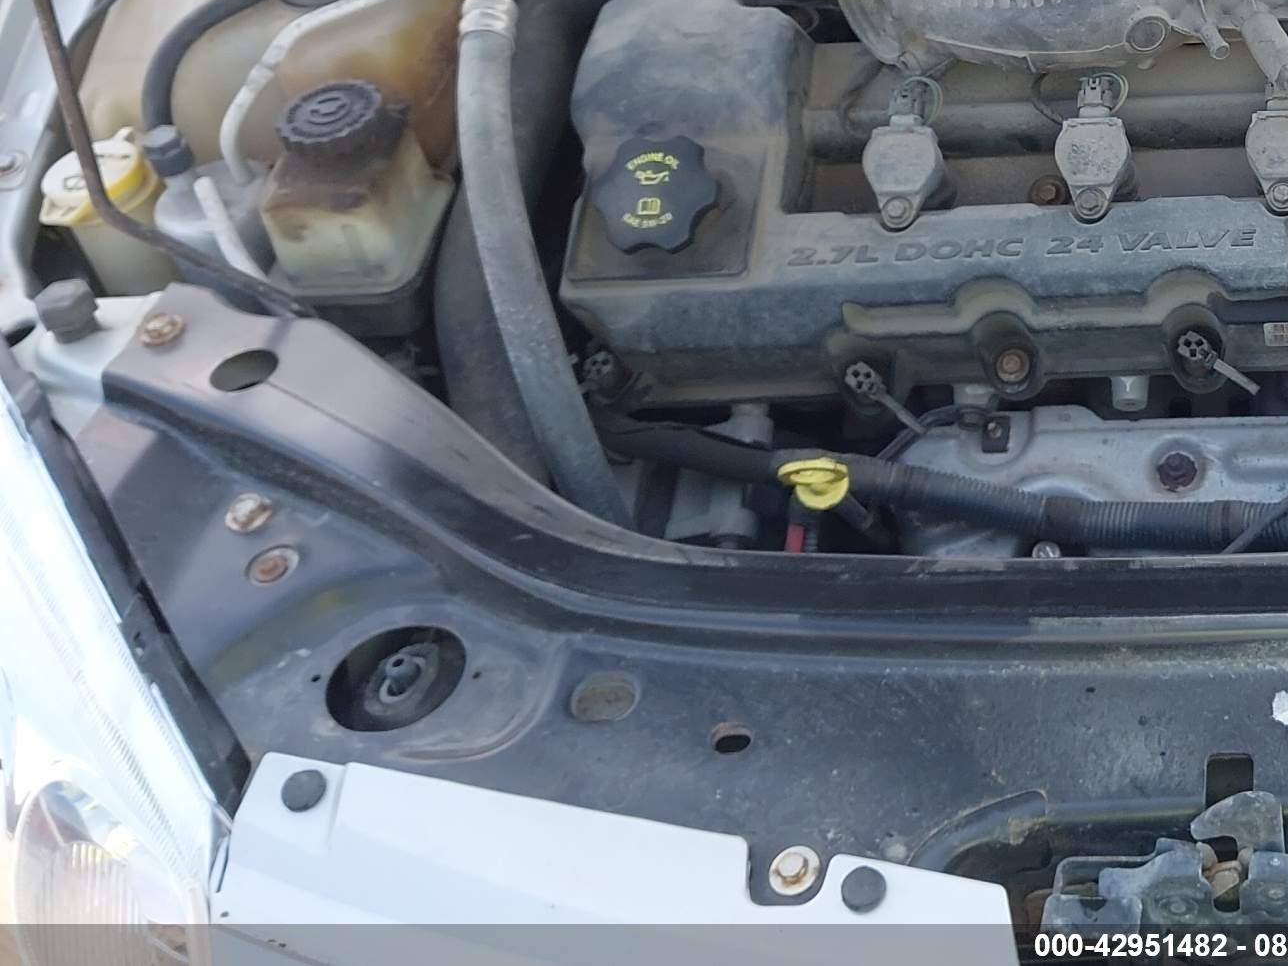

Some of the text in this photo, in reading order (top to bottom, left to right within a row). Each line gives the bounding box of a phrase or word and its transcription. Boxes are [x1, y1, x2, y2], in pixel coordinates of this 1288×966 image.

[624, 151, 664, 170] ENGINE
[786, 228, 1257, 267] 2.7L DOHC 24 VALVE
